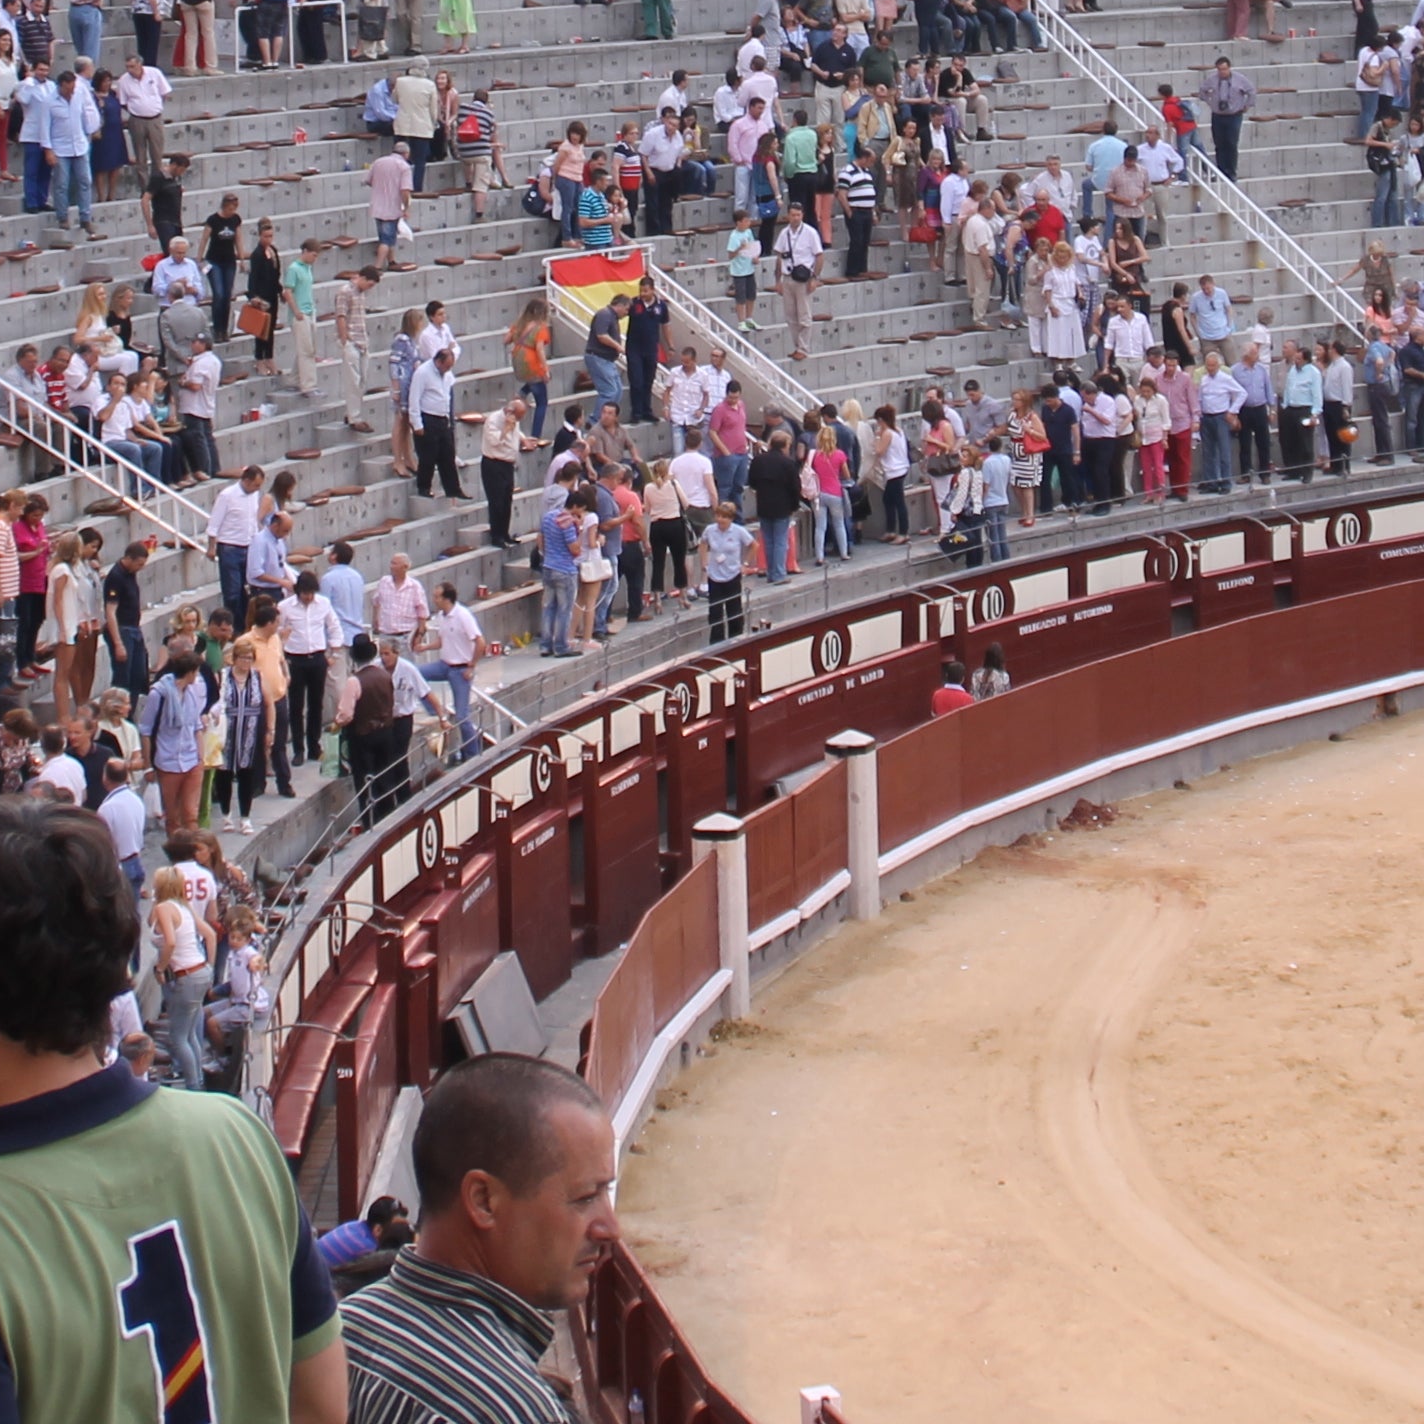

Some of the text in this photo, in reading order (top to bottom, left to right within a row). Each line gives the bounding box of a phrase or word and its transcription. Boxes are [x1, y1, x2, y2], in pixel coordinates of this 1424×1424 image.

[1340, 517, 1358, 544] 10
[985, 590, 1002, 620] 10
[1018, 604, 1113, 636] DELEGADO DE AUTORIDAD
[824, 636, 840, 667] 10
[860, 668, 884, 685] MADRID
[496, 809, 507, 818] 21
[444, 856, 459, 866] 20
[183, 877, 208, 901] 85
[335, 1066, 354, 1080] 20
[116, 1219, 218, 1424] 1
